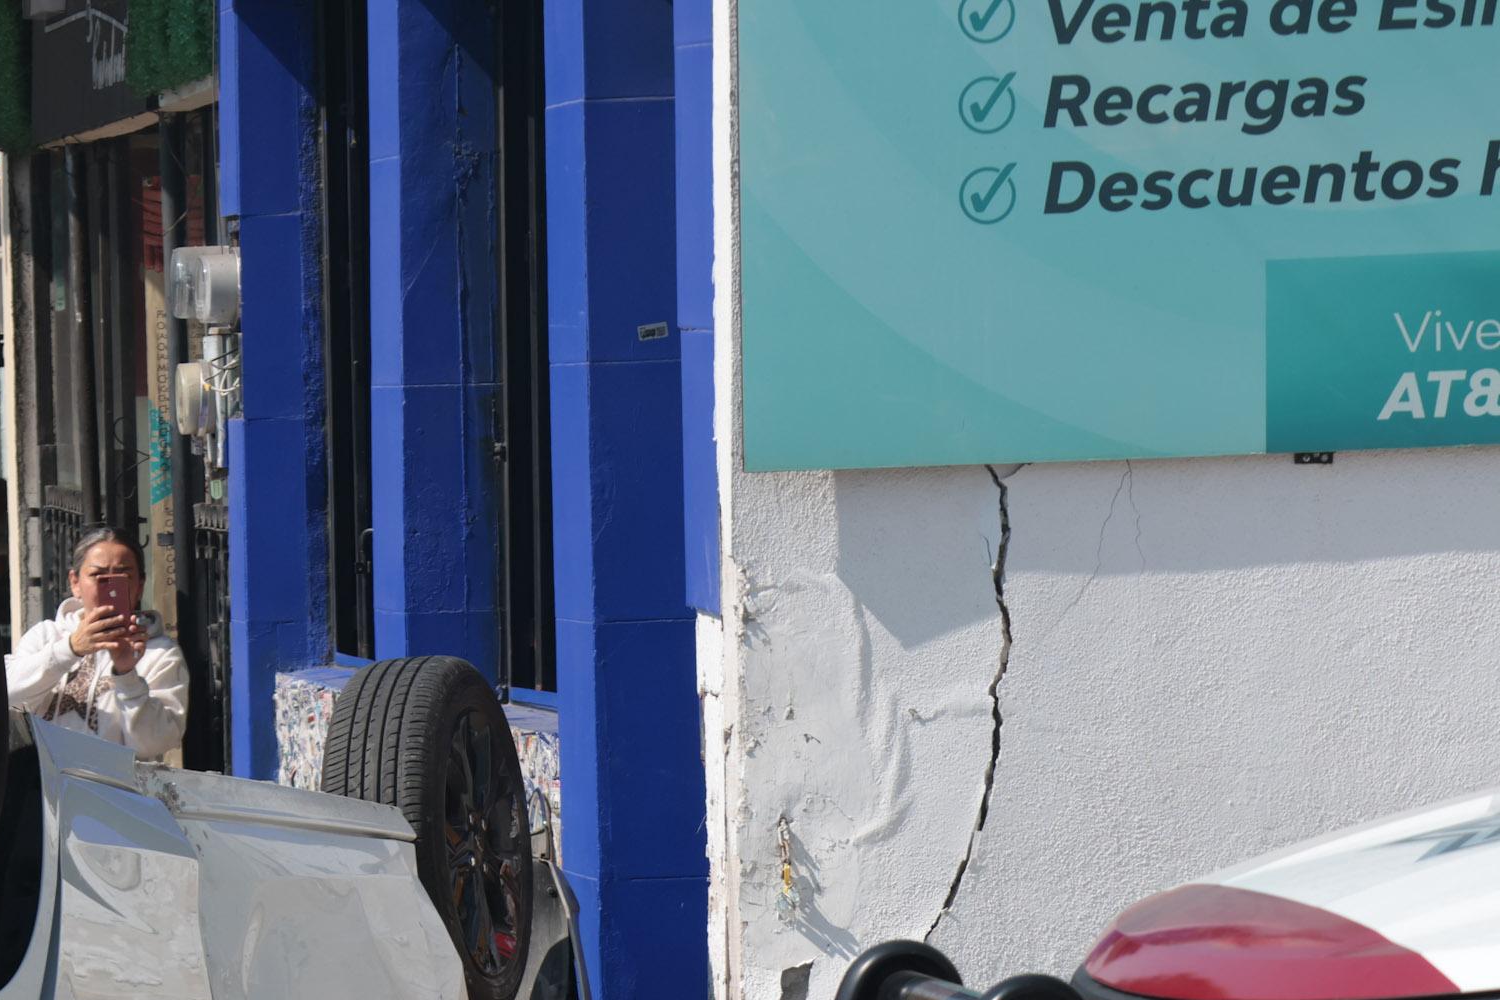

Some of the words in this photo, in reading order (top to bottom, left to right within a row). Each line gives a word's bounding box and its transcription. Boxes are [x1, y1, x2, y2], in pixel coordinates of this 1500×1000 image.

[1048, 0, 1248, 45] Venta
[1269, 0, 1357, 35] de
[1043, 75, 1368, 136] Recargas
[1043, 150, 1462, 214] Descuentos
[1393, 309, 1500, 353] Vive
[1376, 367, 1500, 421] AT&
